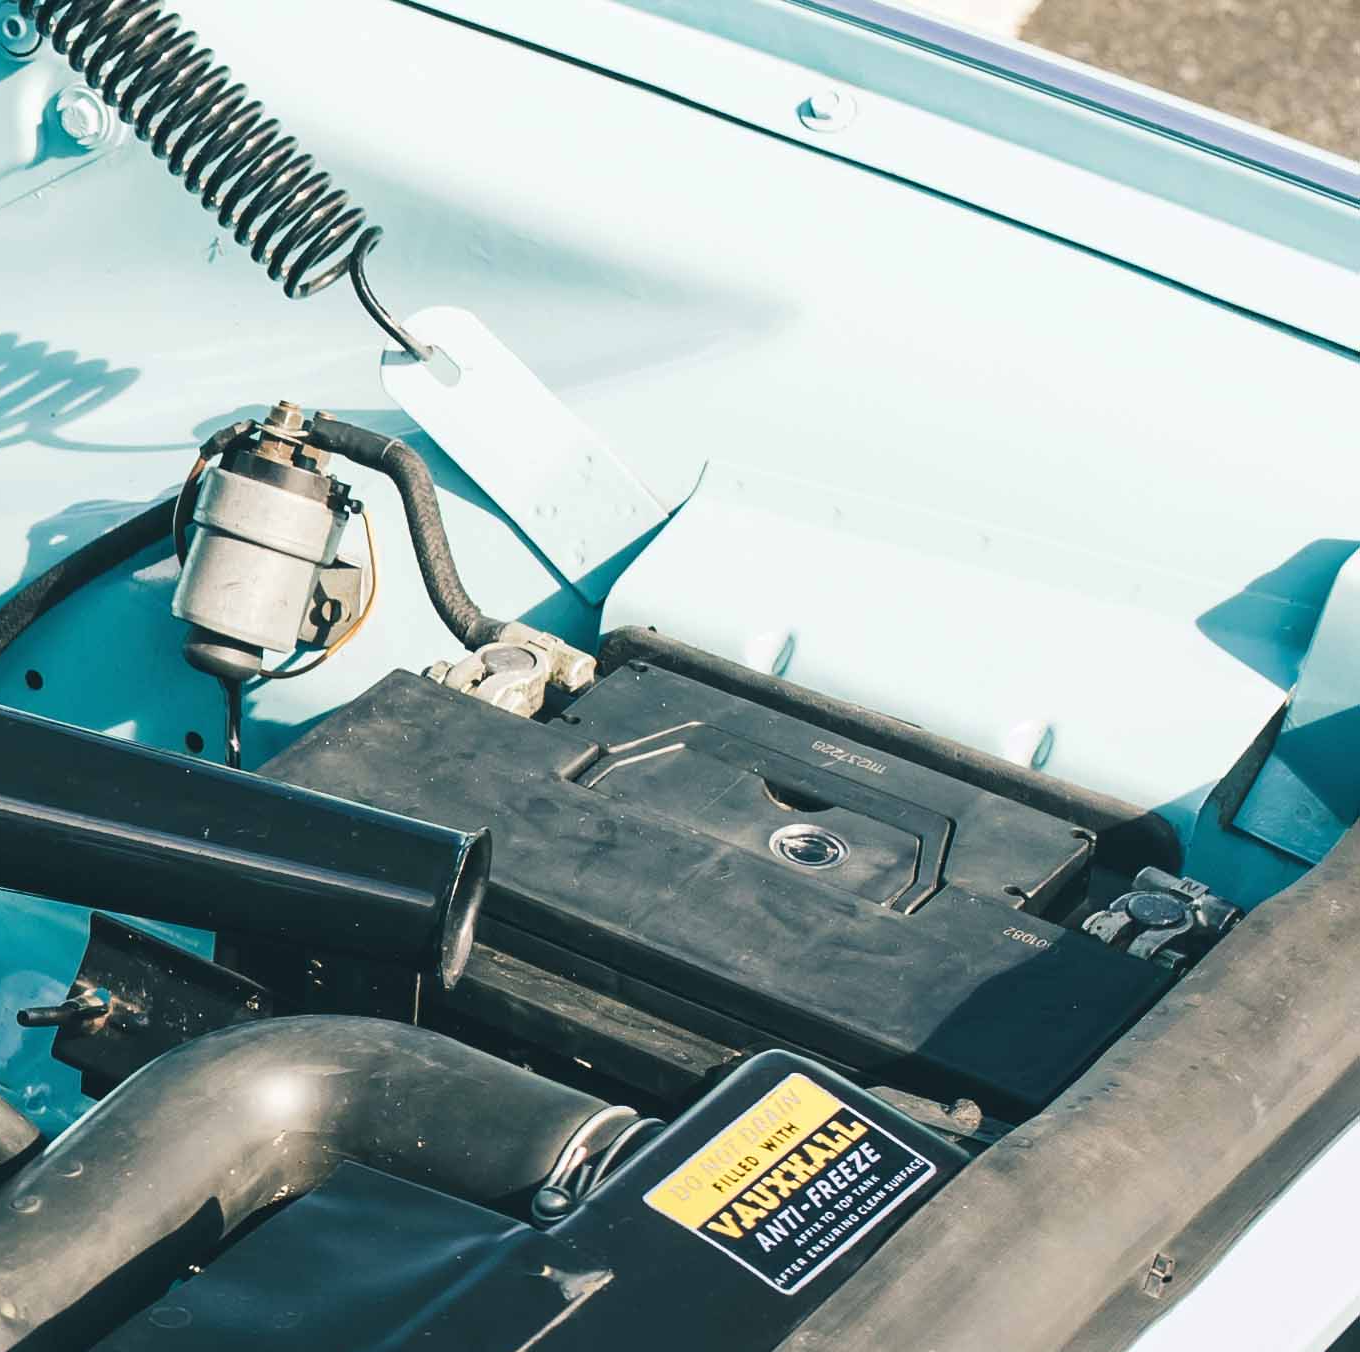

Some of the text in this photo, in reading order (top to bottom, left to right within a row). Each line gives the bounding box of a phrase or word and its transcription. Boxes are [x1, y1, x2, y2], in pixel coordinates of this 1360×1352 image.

[668, 1174, 705, 1202] DO
[741, 1087, 802, 1145] DRAIN
[706, 1116, 870, 1240] VAUXHALL
[712, 1122, 800, 1193] FILLED WITH
[774, 1157, 925, 1287] AFTER ENSURING CLEAN SURFACE
[793, 1174, 880, 1247] AFFIX TO TOP TANK
